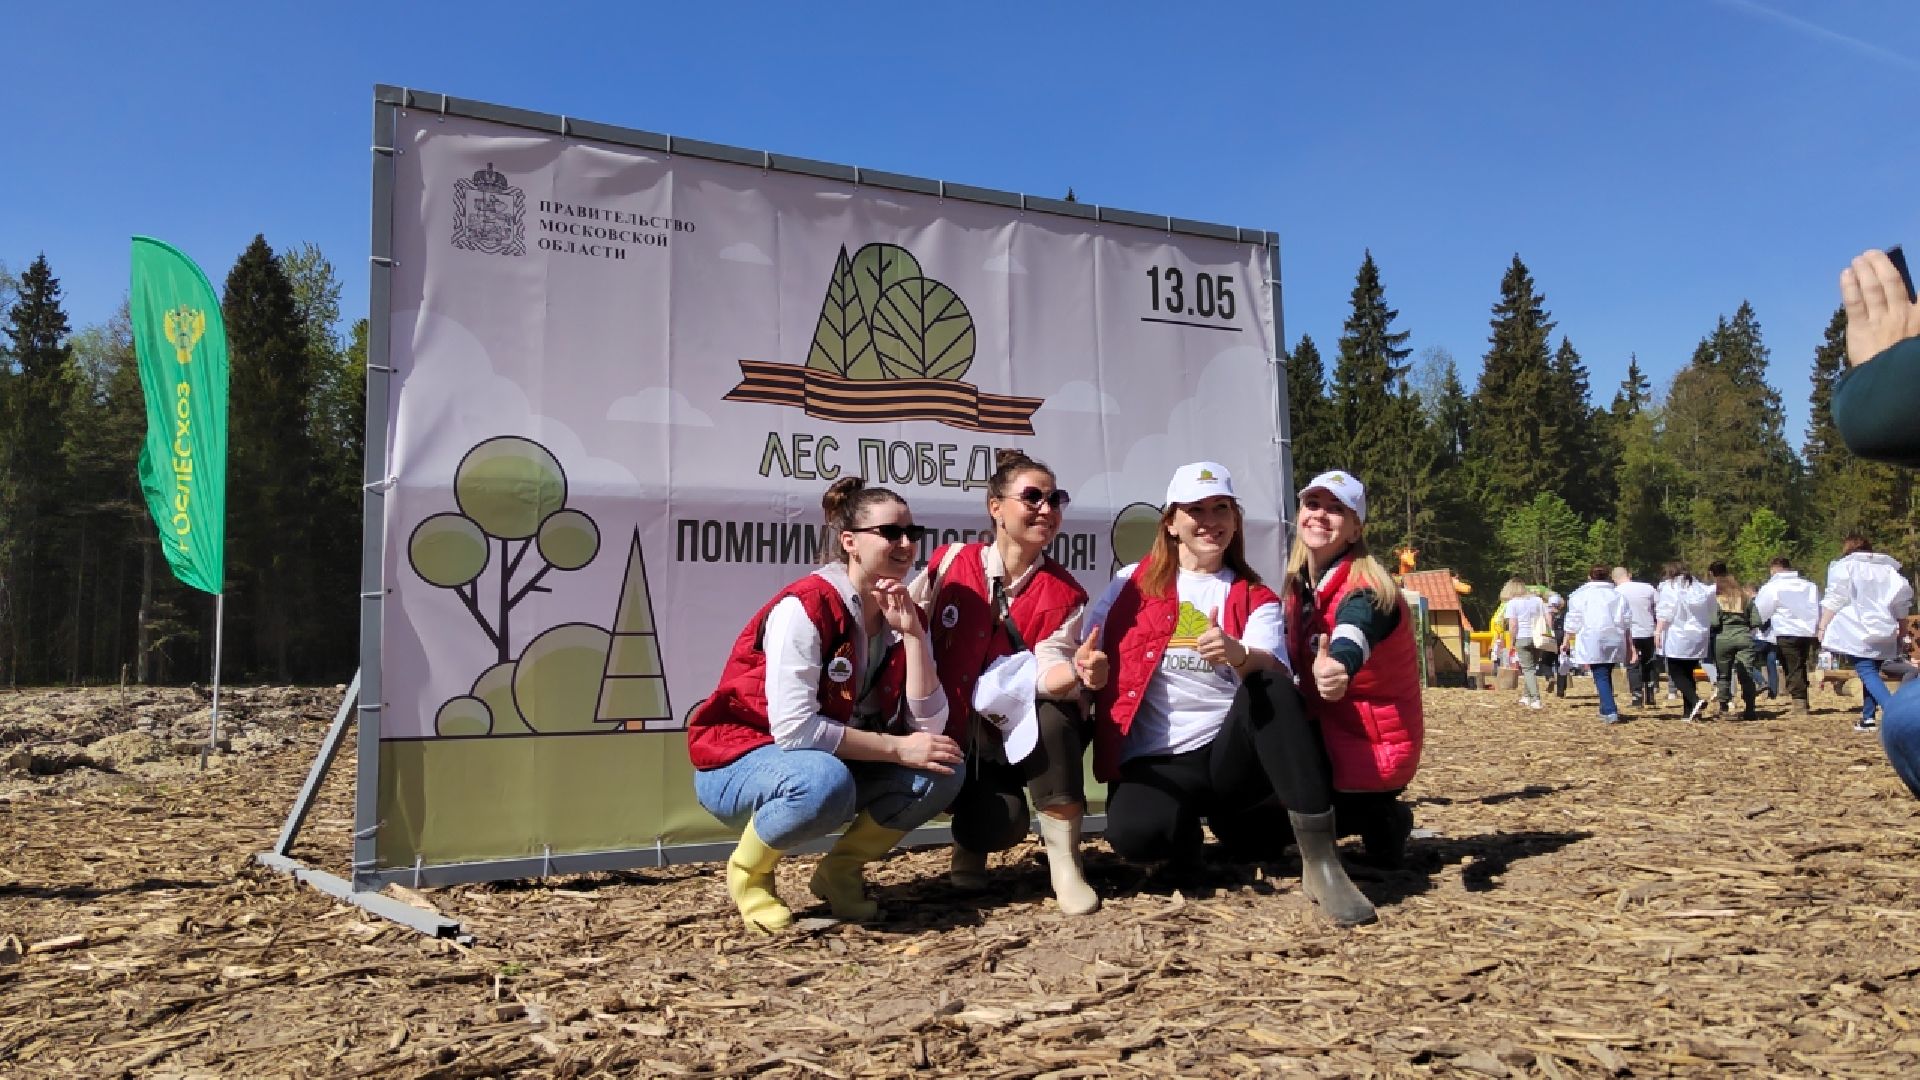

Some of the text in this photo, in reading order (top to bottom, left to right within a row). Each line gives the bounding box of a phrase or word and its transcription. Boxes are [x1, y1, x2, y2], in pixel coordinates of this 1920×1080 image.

[539, 200, 696, 233] ПРАВИТЕЛЬСТВО
[539, 219, 668, 247] МОСКОВСКОЙ
[537, 238, 626, 260] ОБЛАСТИ
[1146, 265, 1235, 320] 13.05
[758, 431, 1023, 492] ЛЕС ПОБЕД
